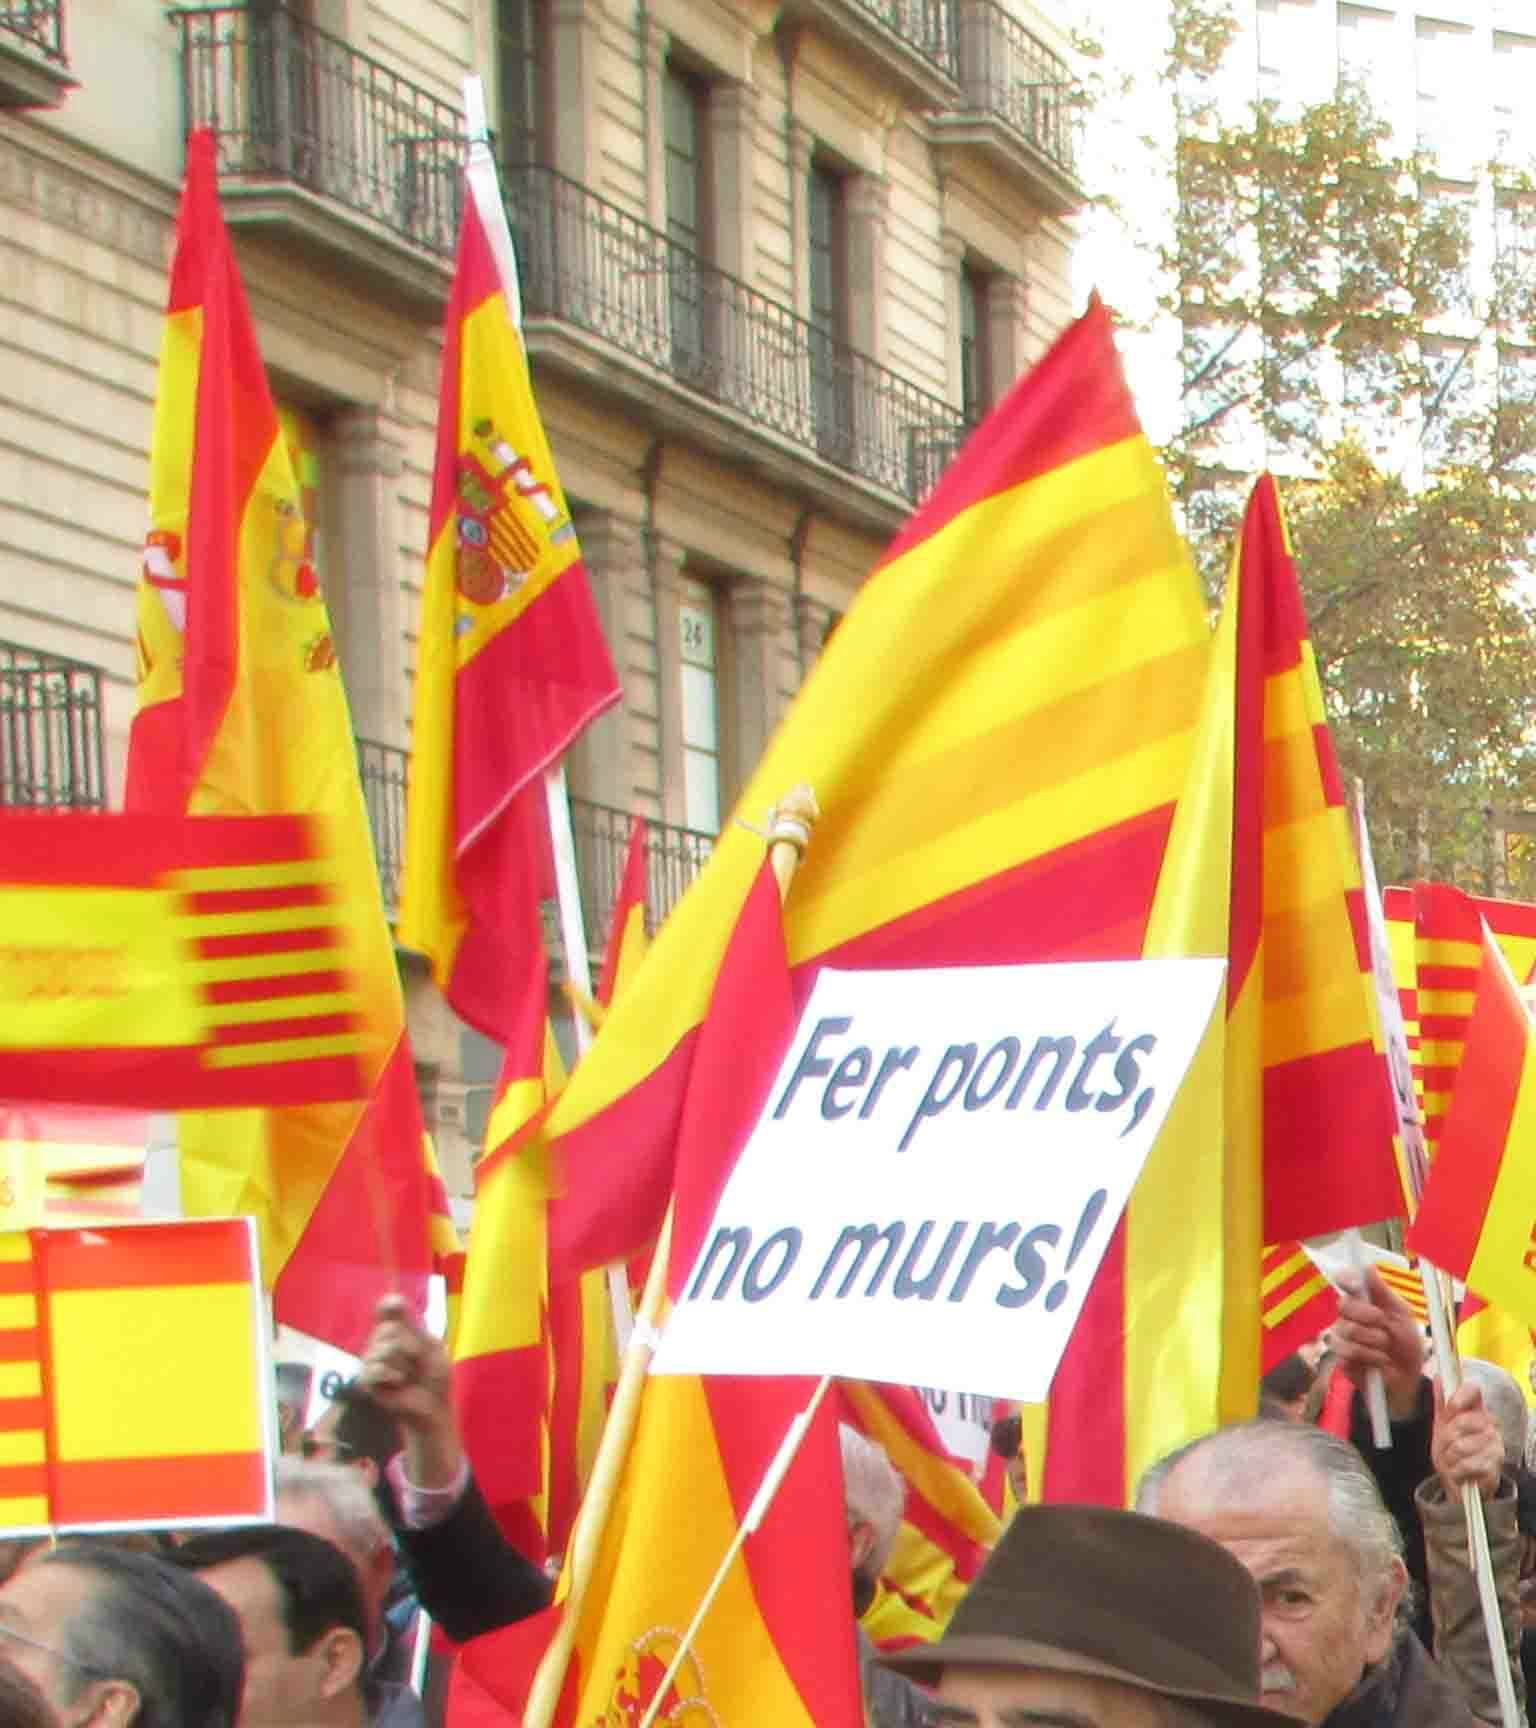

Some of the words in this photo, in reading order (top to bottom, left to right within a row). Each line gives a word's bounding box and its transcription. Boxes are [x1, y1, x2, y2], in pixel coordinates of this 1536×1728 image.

[773, 1016, 920, 1121] Fer
[897, 1020, 1157, 1152] ponts,
[688, 1226, 802, 1303] no
[808, 1189, 1107, 1313] murs!
